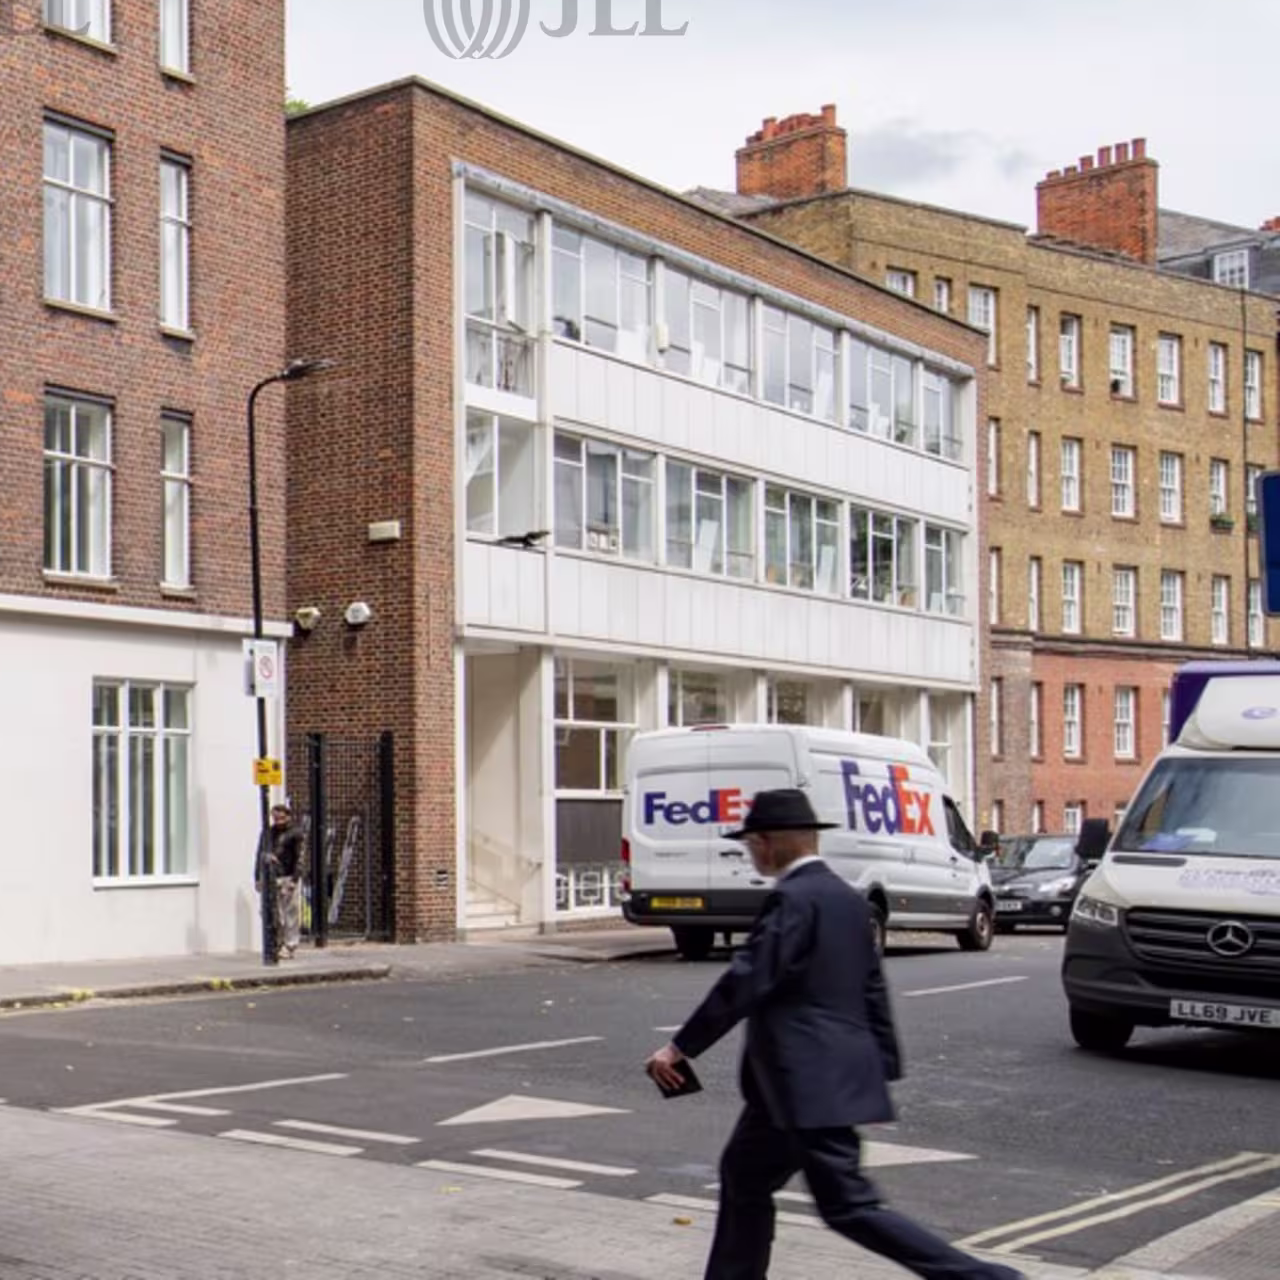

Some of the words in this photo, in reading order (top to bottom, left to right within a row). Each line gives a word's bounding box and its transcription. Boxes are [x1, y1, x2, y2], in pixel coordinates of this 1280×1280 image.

[841, 760, 935, 836] FedEx
[1178, 1002, 1228, 1021] LL69
[1233, 1008, 1273, 1024] JVE
